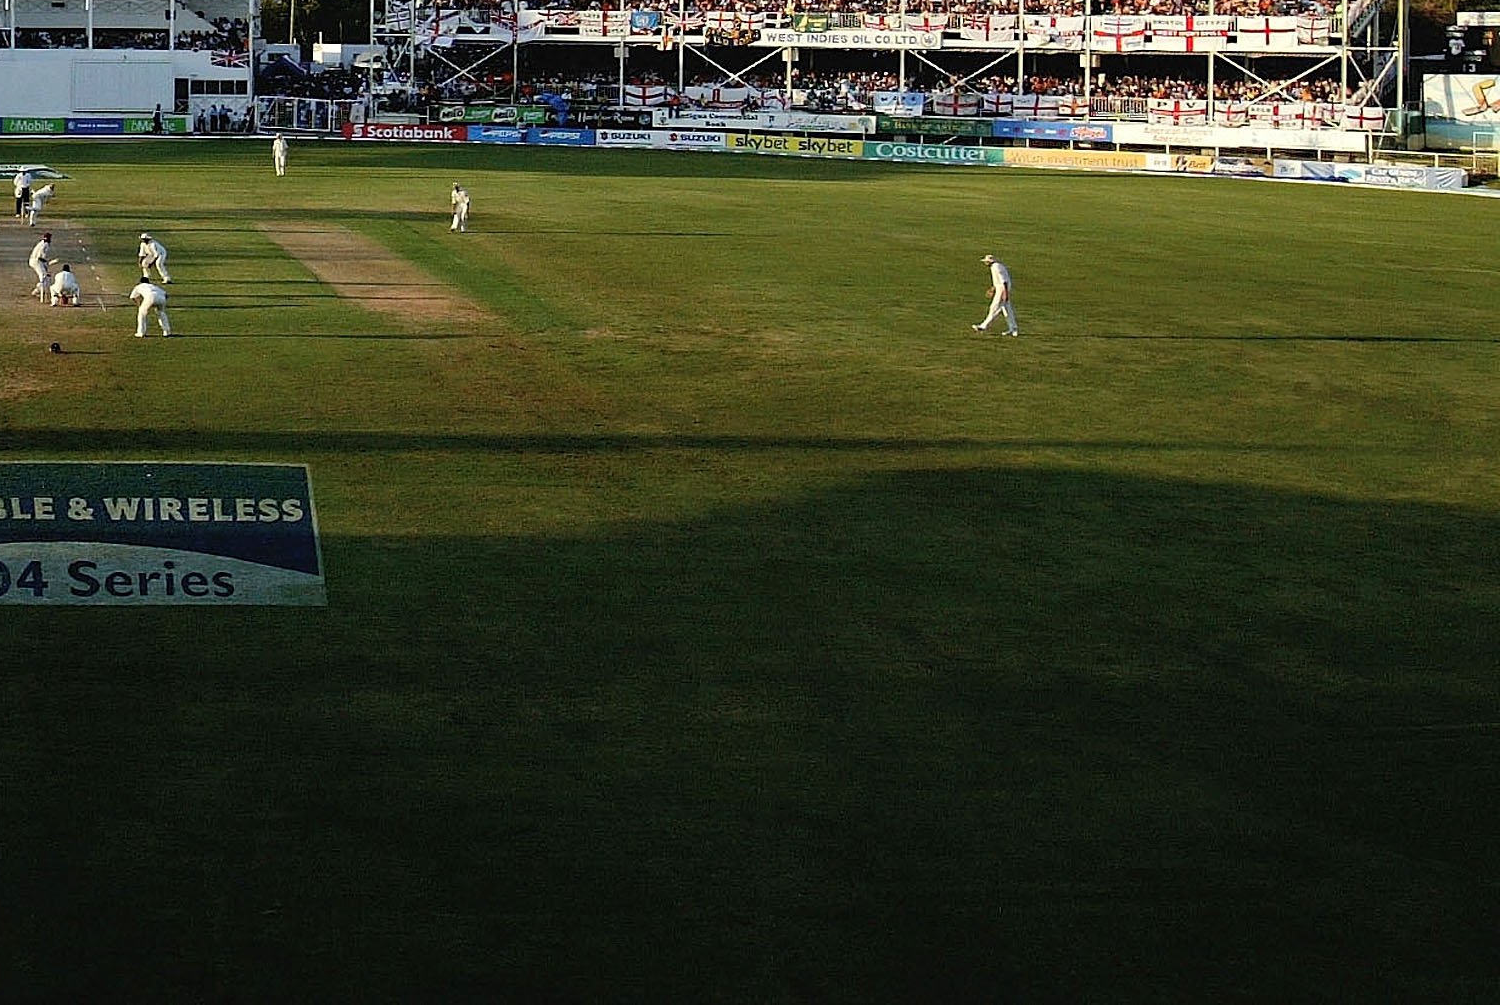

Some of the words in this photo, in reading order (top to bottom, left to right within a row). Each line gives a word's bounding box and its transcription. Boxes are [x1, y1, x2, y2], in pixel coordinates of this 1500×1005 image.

[766, 32, 803, 43] WEST
[807, 33, 847, 44] INDIES
[853, 34, 872, 44] OIL
[367, 125, 453, 139] Scotiabank
[681, 134, 721, 142] SUZUKI
[735, 134, 790, 150] skybet
[798, 139, 853, 154] skybet
[876, 143, 986, 161] Costcutter
[68, 497, 95, 522] &
[104, 497, 303, 523] WIRELESS
[69, 560, 235, 597] Series
